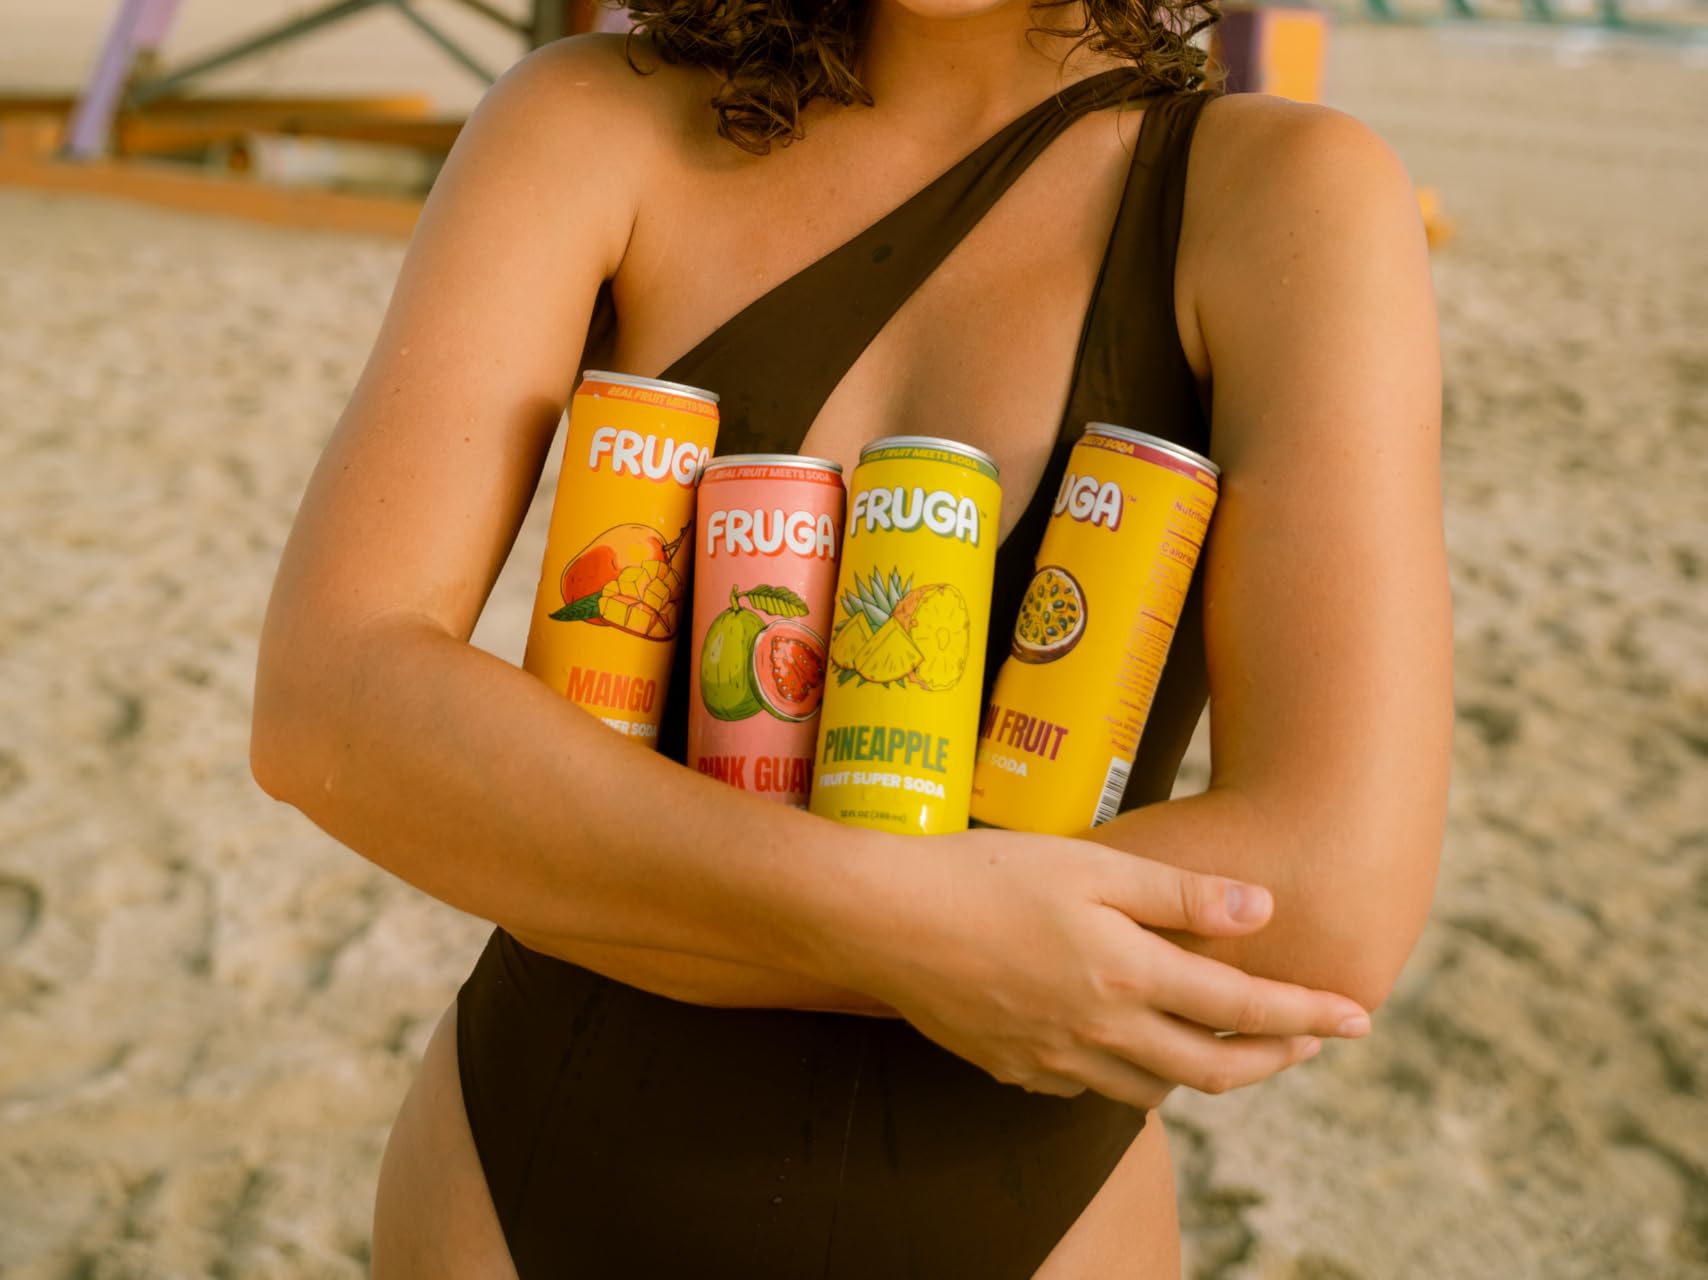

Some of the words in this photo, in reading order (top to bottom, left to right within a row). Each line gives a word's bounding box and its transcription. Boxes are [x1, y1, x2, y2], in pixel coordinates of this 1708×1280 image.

[738, 466, 768, 478] FRUIT
[851, 486, 979, 546] FRUGA
[1054, 472, 1122, 530] UGA
[707, 508, 836, 560] FRUGA
[565, 665, 657, 714] MANGO
[822, 725, 950, 774] PINEAPPLE
[996, 707, 1069, 761] FRUIT
[852, 771, 902, 789] SUPER
[904, 775, 946, 800] SODA
[992, 753, 1028, 777] SODA
